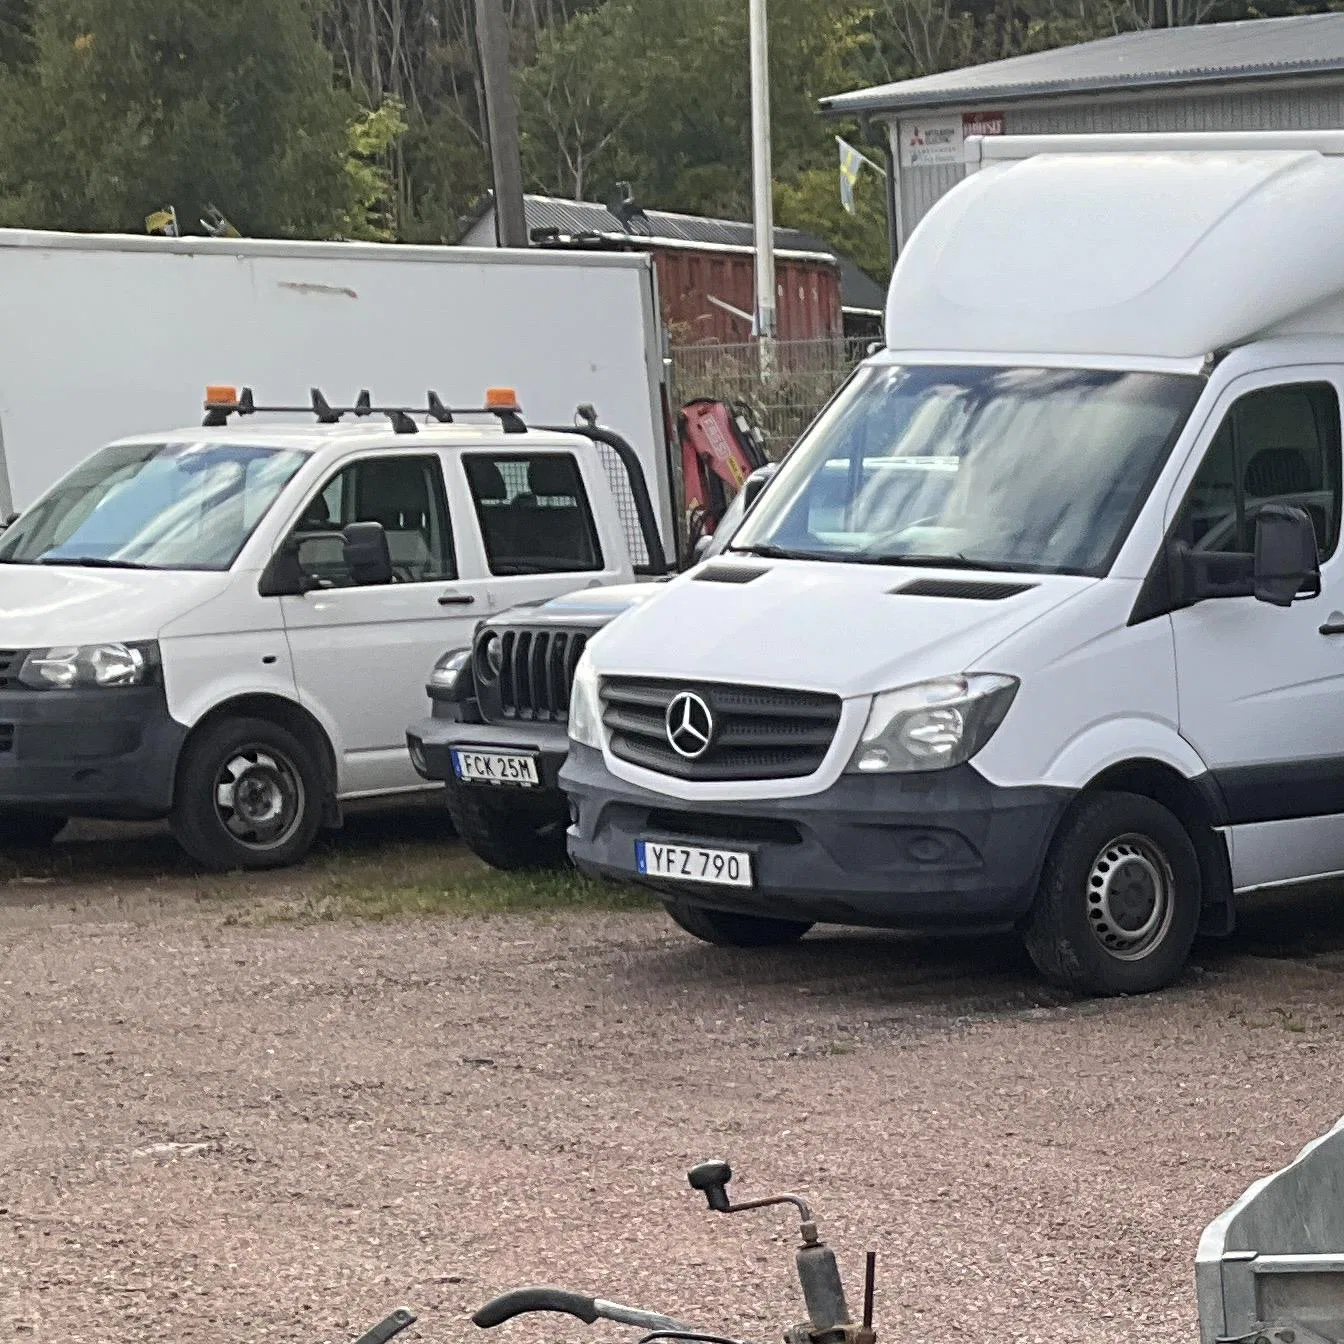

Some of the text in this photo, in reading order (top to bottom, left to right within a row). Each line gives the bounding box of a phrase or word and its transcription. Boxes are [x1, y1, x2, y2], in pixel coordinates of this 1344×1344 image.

[463, 754, 532, 778] FCK 25M
[652, 846, 739, 880] YFZ 790
